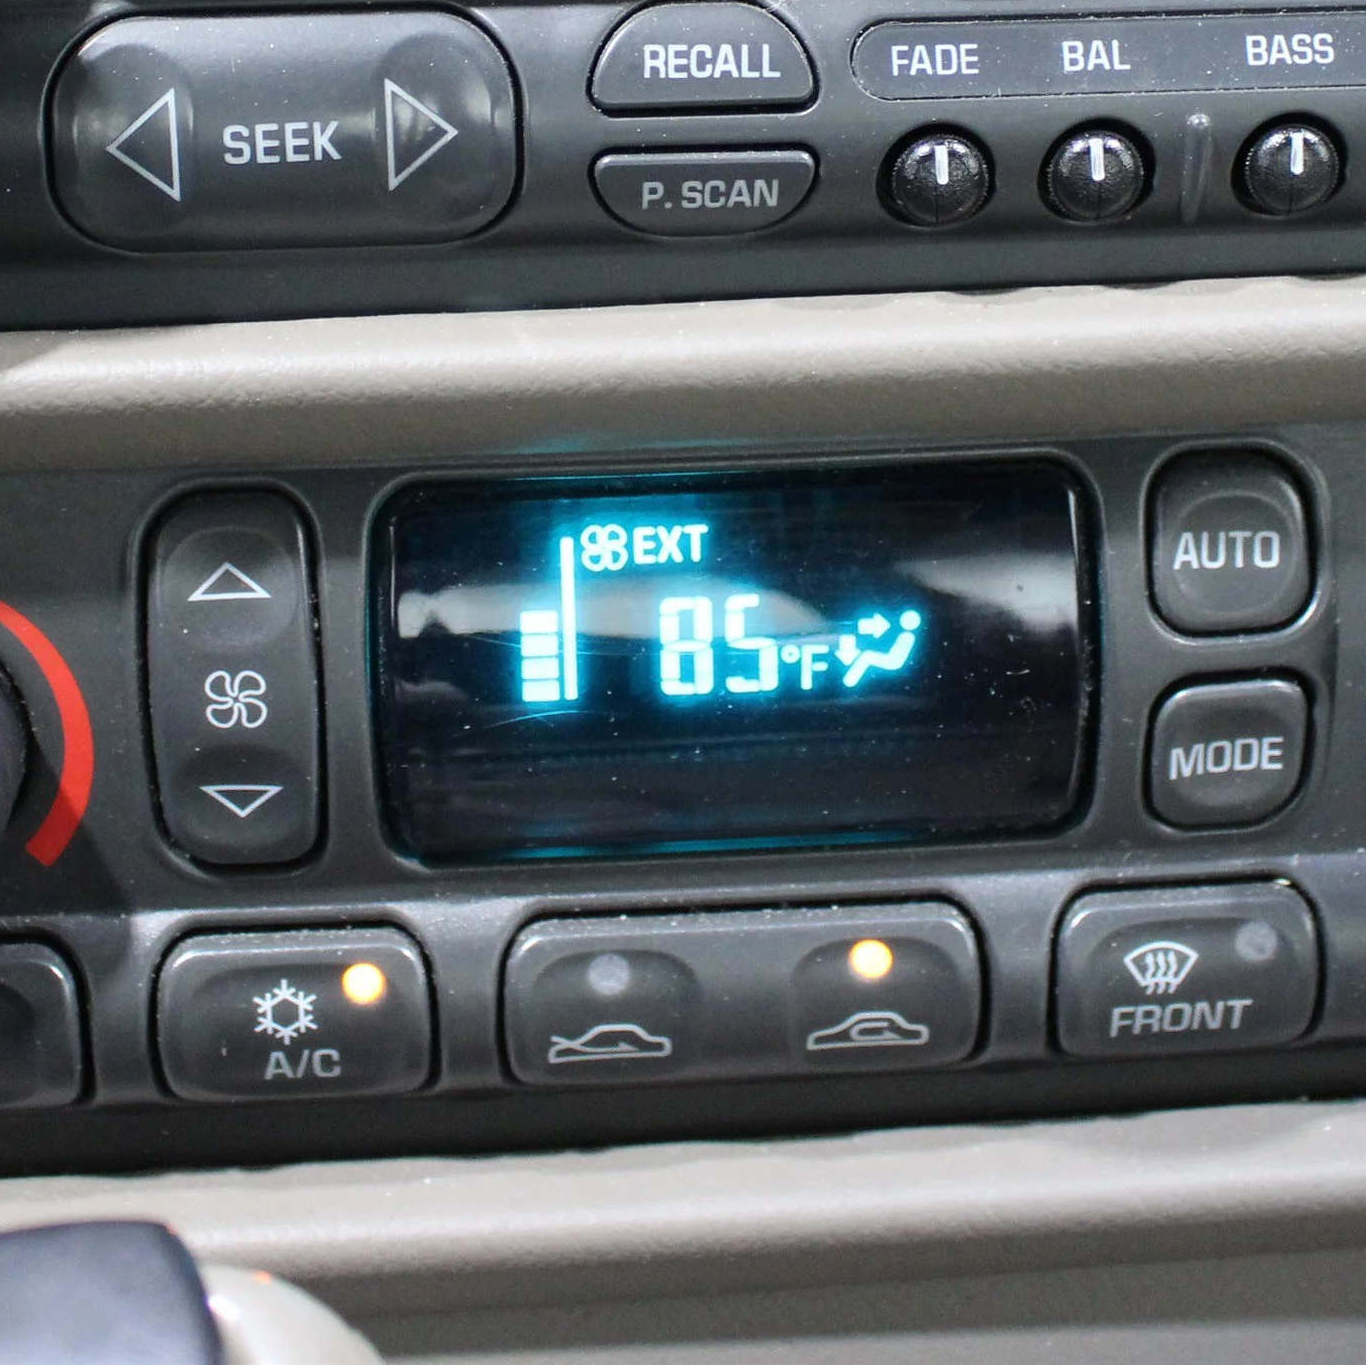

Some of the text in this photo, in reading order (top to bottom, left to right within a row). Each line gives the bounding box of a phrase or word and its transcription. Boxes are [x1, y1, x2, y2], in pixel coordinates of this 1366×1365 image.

[643, 43, 781, 79] RECALL
[890, 43, 980, 77] FADE
[1061, 39, 1131, 74] BAL
[1245, 32, 1335, 66] BASS
[222, 119, 341, 164] SEEK
[633, 523, 710, 566] EXT
[1171, 531, 1280, 571] AUTO
[1169, 736, 1284, 781] MODE
[1110, 998, 1254, 1037] FRONT
[264, 1047, 342, 1080] A/C
